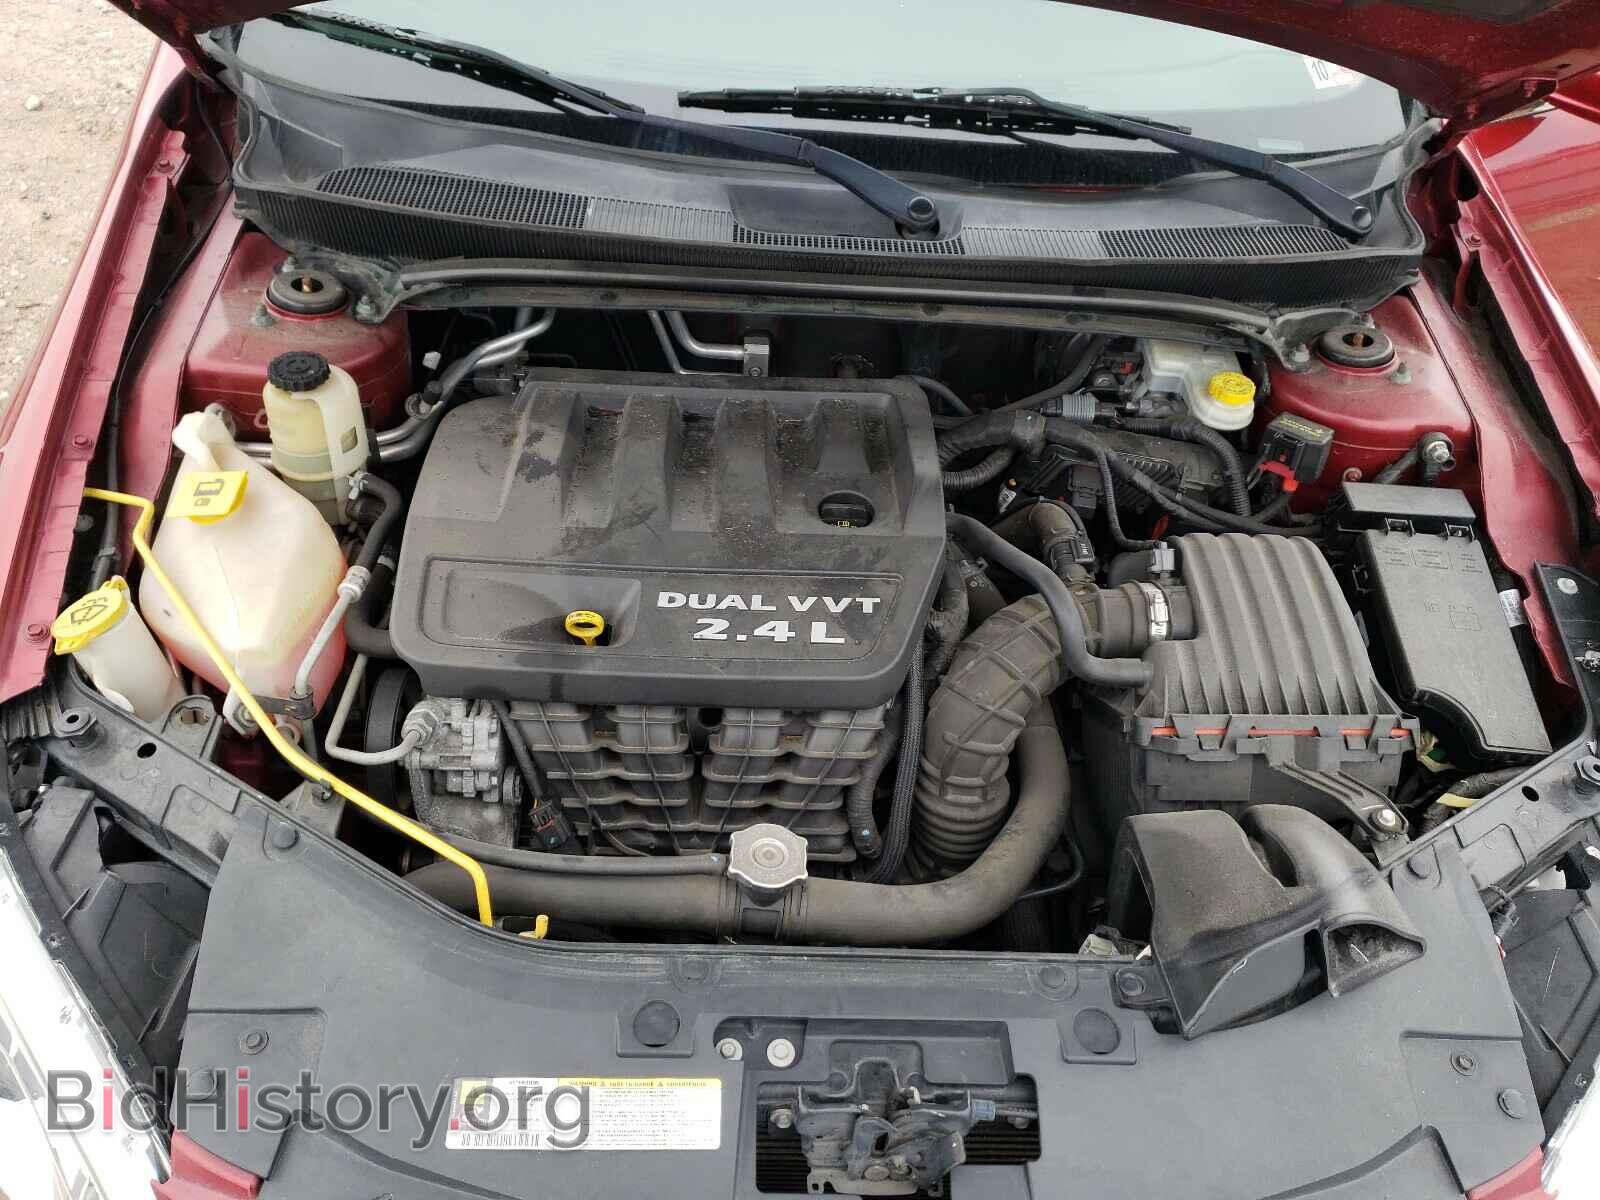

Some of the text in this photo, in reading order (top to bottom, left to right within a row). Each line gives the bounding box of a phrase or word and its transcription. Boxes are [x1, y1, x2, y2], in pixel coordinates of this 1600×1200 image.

[1311, 60, 1329, 81] 10
[656, 591, 881, 614] DUAL VVT
